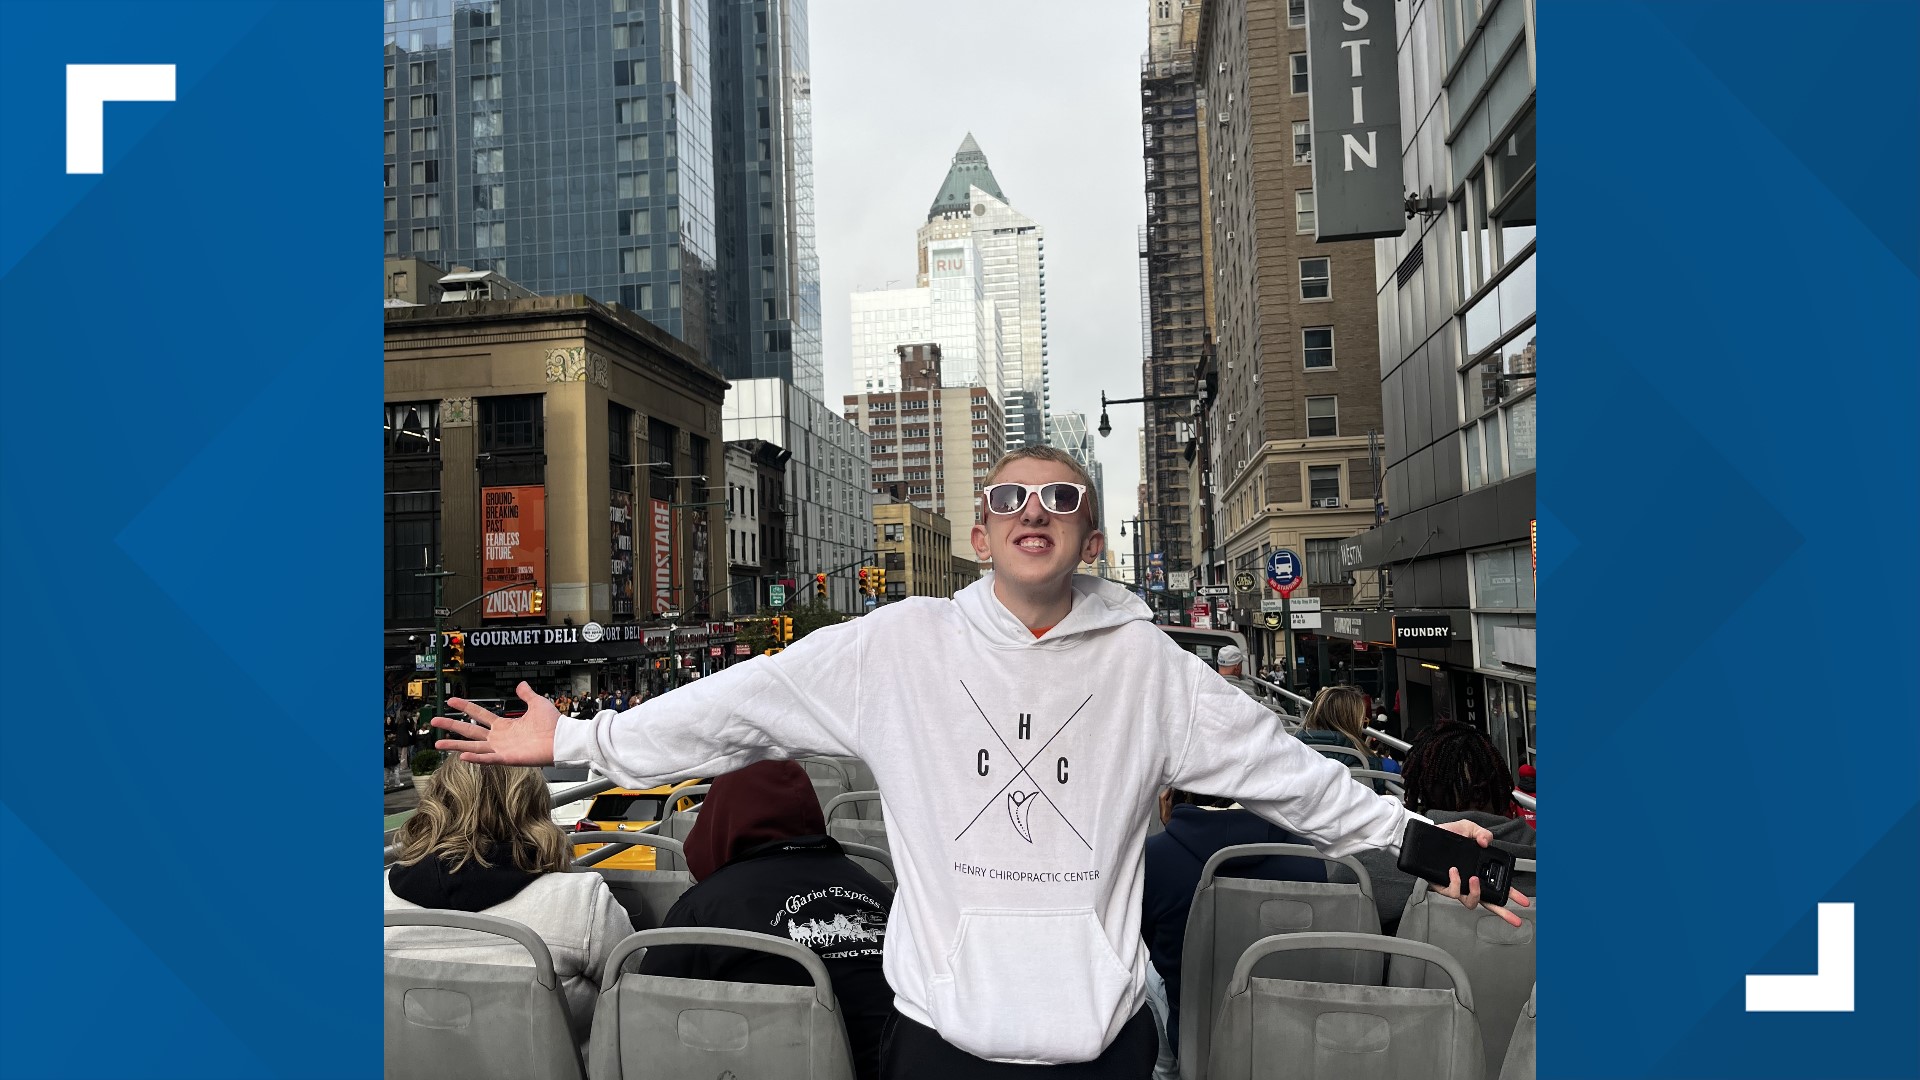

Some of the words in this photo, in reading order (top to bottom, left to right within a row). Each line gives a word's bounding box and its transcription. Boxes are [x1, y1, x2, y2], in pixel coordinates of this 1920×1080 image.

[1340, 0, 1377, 172] STIN
[936, 258, 963, 272] RIU
[486, 492, 515, 506] GROUND-
[486, 505, 519, 519] BREAKING
[486, 519, 505, 533] PAST.
[486, 532, 520, 547] FEARLESS
[486, 546, 514, 560] FUTURE.
[1340, 544, 1362, 566] WESTIN
[1269, 579, 1277, 587] NO
[1276, 577, 1300, 591] STANDING
[487, 589, 535, 613] 2NDSTA
[471, 630, 541, 646] GOURMET
[544, 628, 577, 644] DELI
[624, 625, 640, 640] DELI
[1398, 627, 1449, 637] FOUNDRY
[1018, 713, 1032, 740] H
[977, 748, 990, 777] C
[1056, 756, 1069, 784] C
[954, 861, 986, 878] HENRY
[989, 868, 1062, 883] CHIROPRACTIC
[1063, 870, 1100, 882] CENTER
[828, 886, 881, 909] Express
[821, 950, 859, 959] CING
[861, 948, 884, 956] TEA
